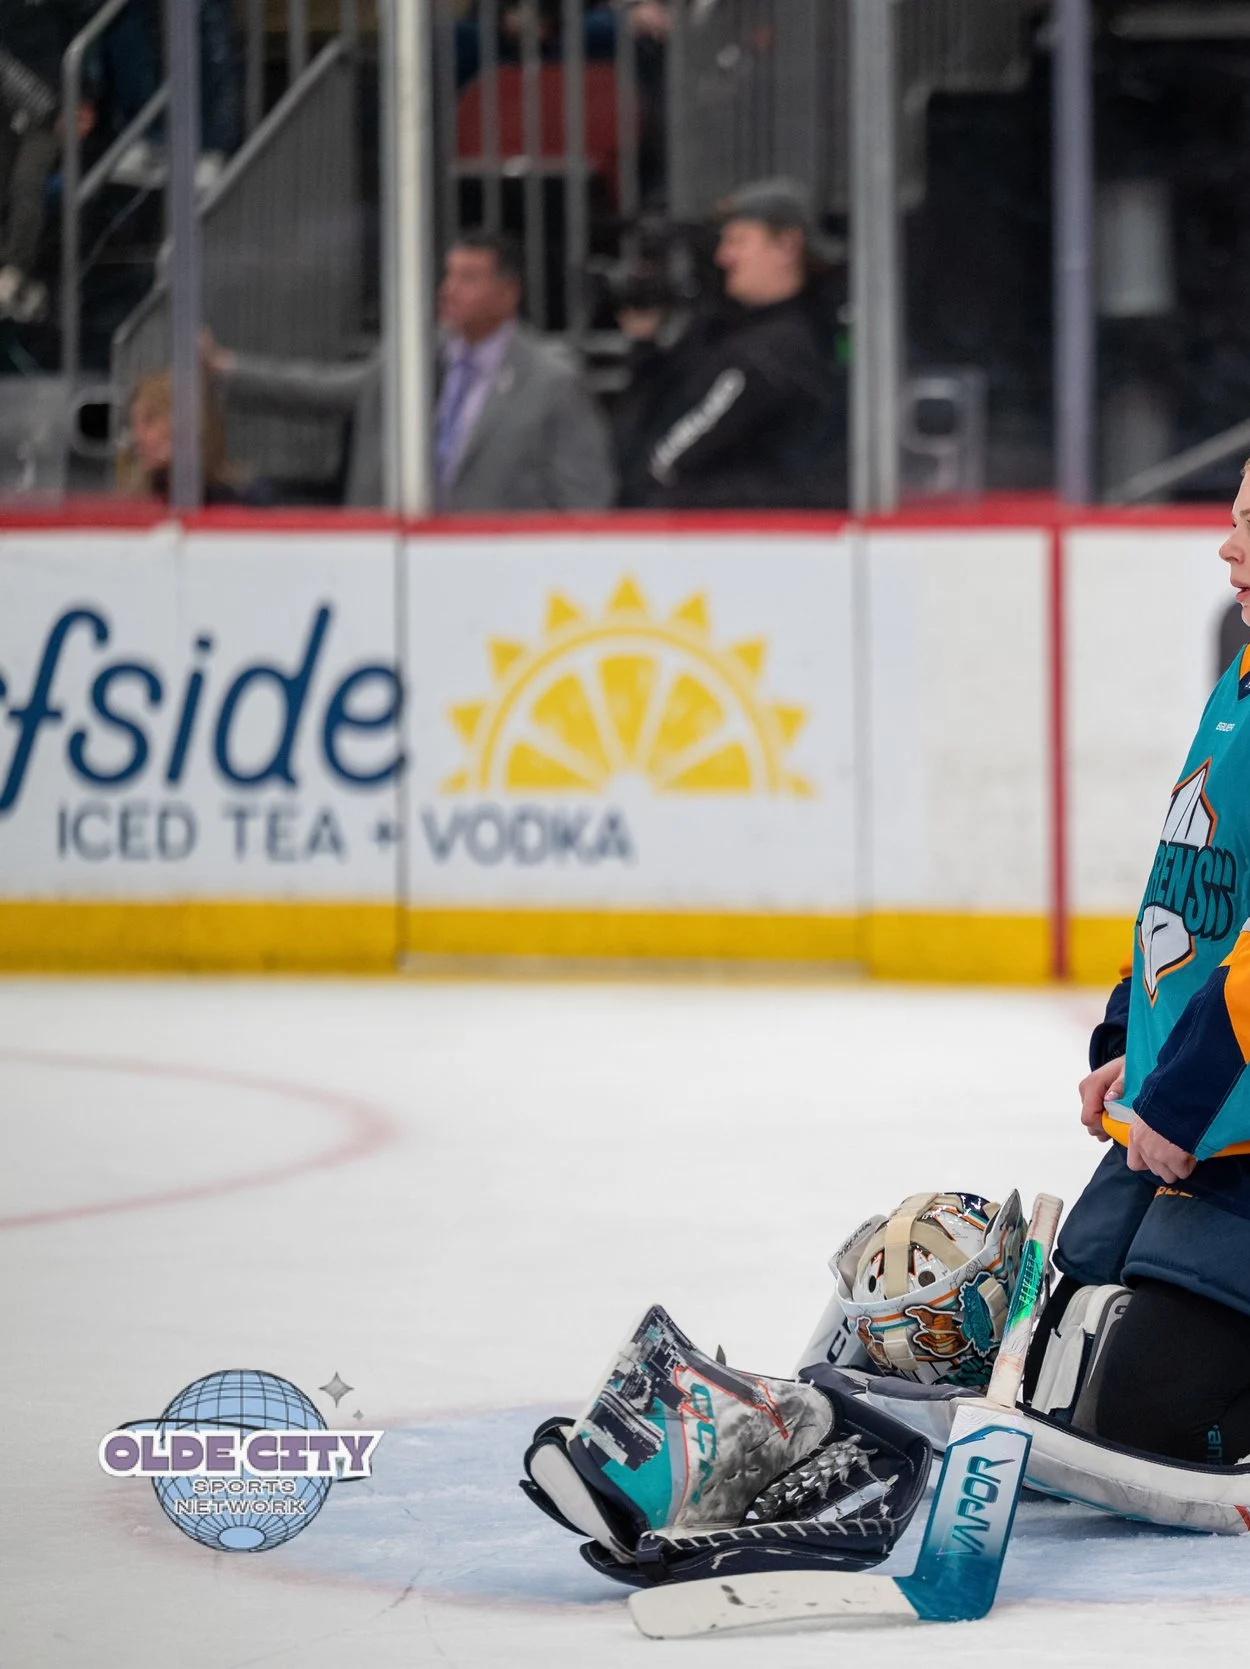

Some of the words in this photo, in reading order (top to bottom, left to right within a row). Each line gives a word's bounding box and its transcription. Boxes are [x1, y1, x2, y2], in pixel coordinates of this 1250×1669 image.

[0, 605, 411, 818] fside
[56, 806, 198, 864] ICED
[222, 808, 348, 864] TEA
[420, 808, 637, 867] VODKA
[944, 1455, 1016, 1556] VAPOR
